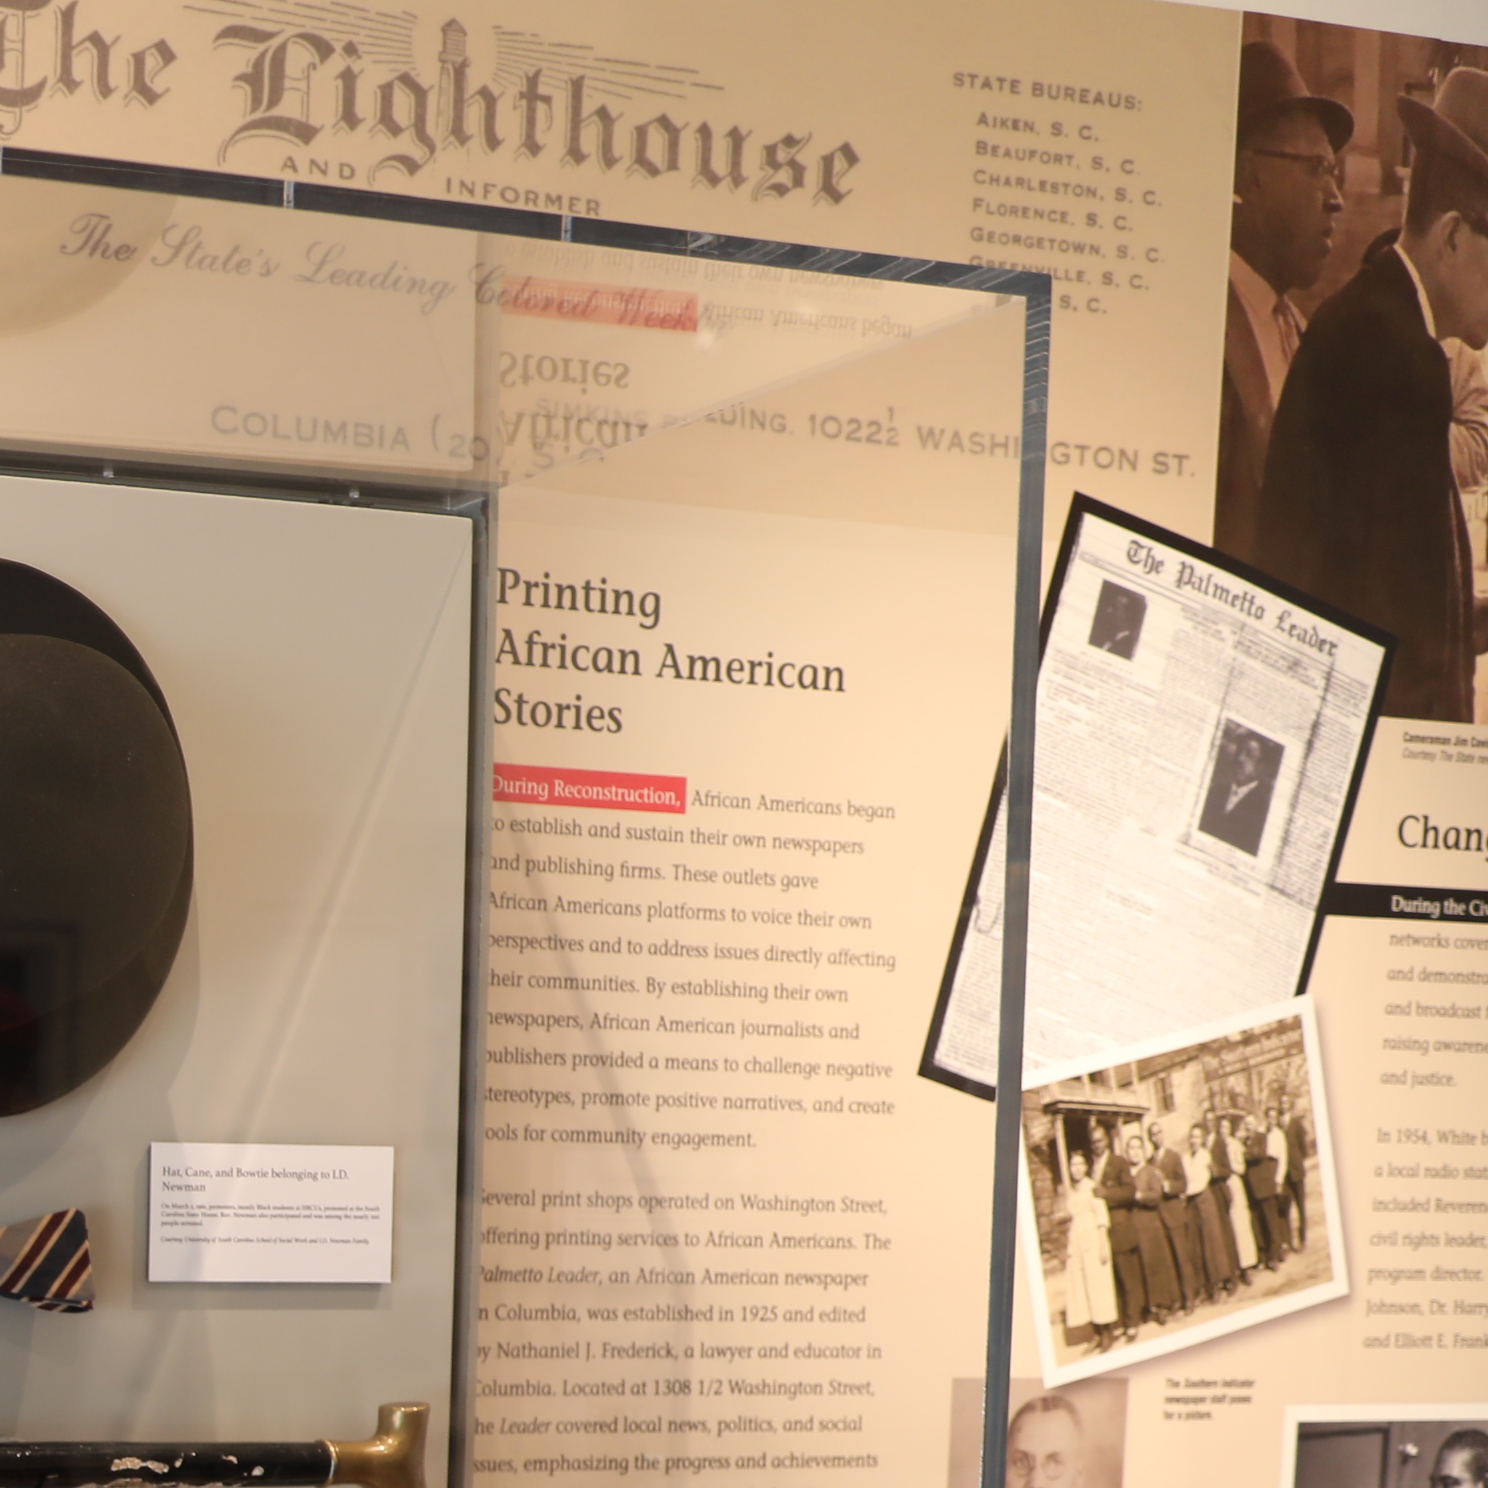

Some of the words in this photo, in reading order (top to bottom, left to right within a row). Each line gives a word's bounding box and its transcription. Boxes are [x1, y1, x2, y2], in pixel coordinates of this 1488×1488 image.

[953, 70, 1022, 97] STATE
[1031, 81, 1142, 112] BUREAUS:
[213, 22, 861, 206] Lighthouse
[975, 140, 1081, 171] BEAUFORT,
[281, 155, 357, 181] AND
[446, 176, 601, 217] INFORMER
[973, 170, 1106, 203] CHARLESTON,
[972, 198, 1075, 227] FLORENCE,
[970, 226, 1107, 260] GEORGETOWN,
[151, 224, 280, 279] State's
[293, 242, 455, 315] Leading
[497, 567, 662, 630] Printing
[1124, 538, 1165, 576] The
[1175, 561, 1265, 621] Palmetto
[1274, 609, 1339, 658] Leader
[496, 628, 641, 676] African
[656, 643, 846, 692] American
[493, 687, 623, 734] Stories
[553, 778, 681, 808] Reconstruction,
[691, 789, 751, 811] African
[757, 793, 842, 818] Americans
[846, 801, 896, 821] began
[162, 1181, 206, 1192] Newman
[236, 1168, 269, 1179] Bowtie
[271, 1168, 319, 1182] belonging
